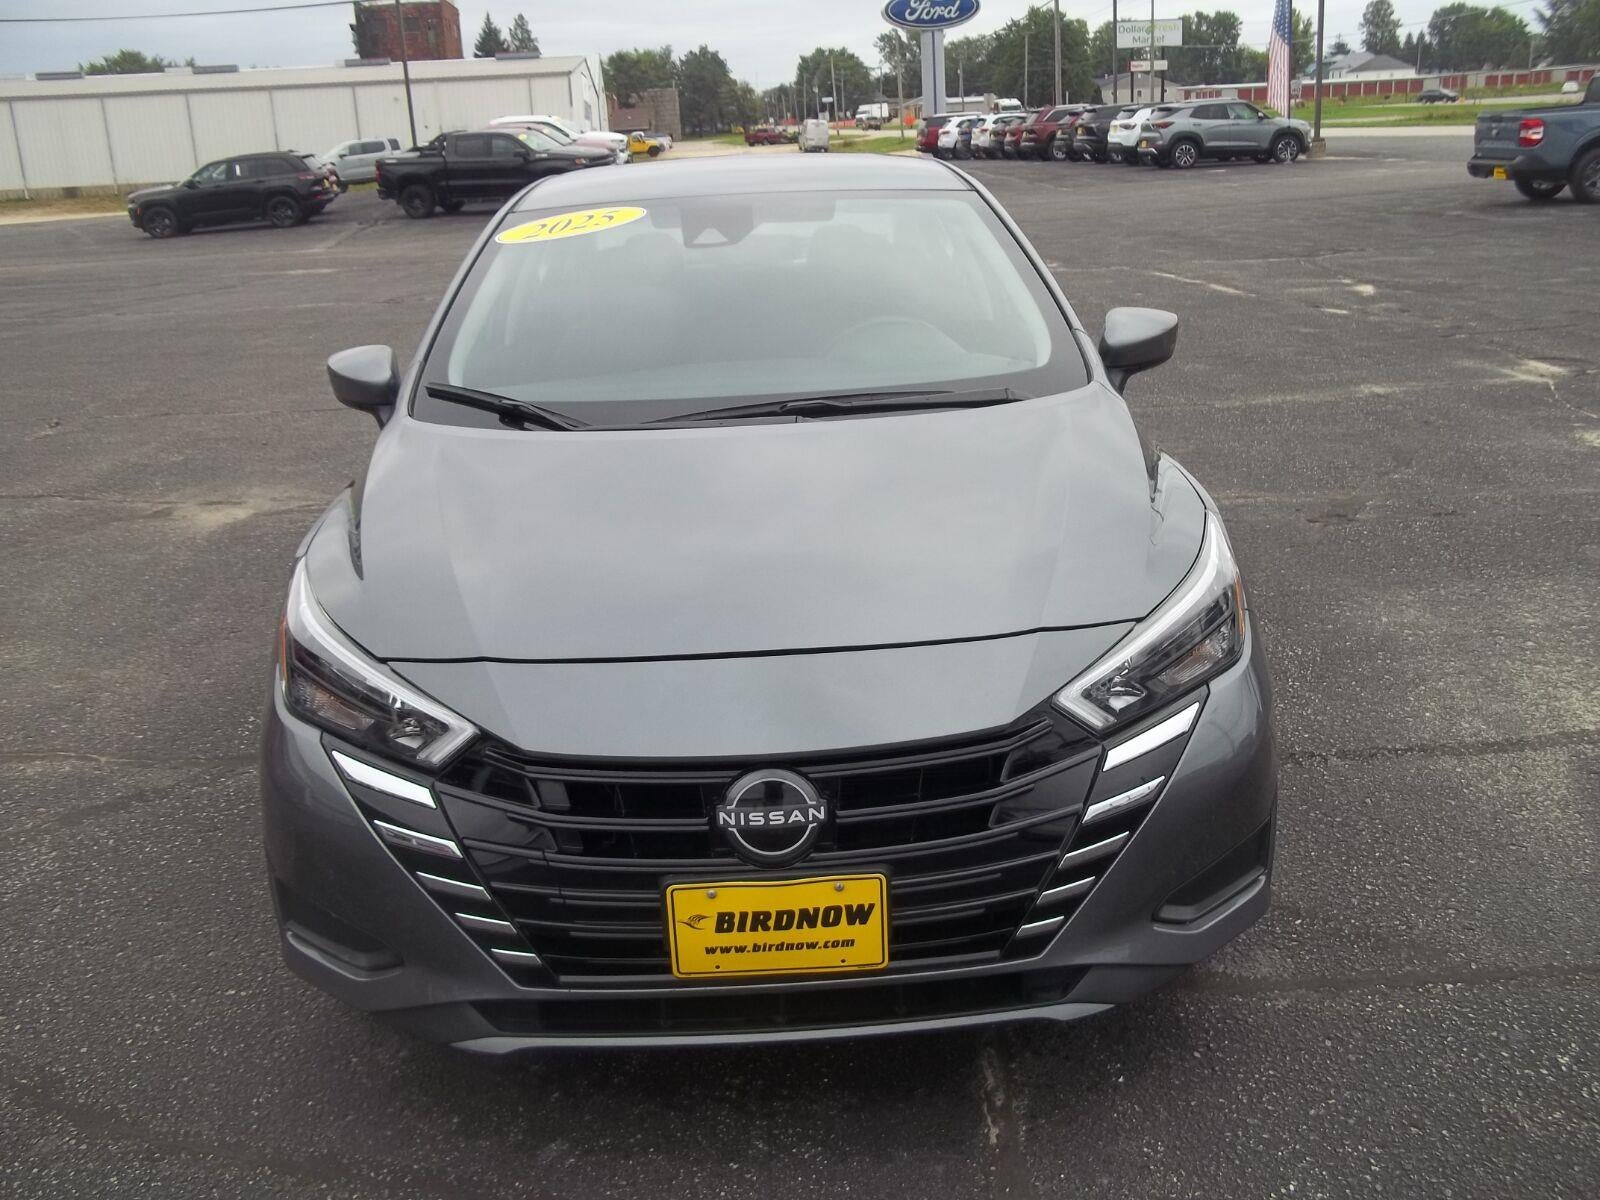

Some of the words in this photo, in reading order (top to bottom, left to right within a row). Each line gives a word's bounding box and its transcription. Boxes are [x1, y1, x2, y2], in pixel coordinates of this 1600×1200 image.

[905, 0, 960, 20] Ford
[1119, 24, 1145, 34] Dollar
[1132, 35, 1165, 44] Maret
[522, 209, 622, 240] 2025
[719, 806, 825, 826] NISSAN
[714, 903, 875, 934] BIRDNOW
[704, 939, 855, 955] www.birdnow.com
